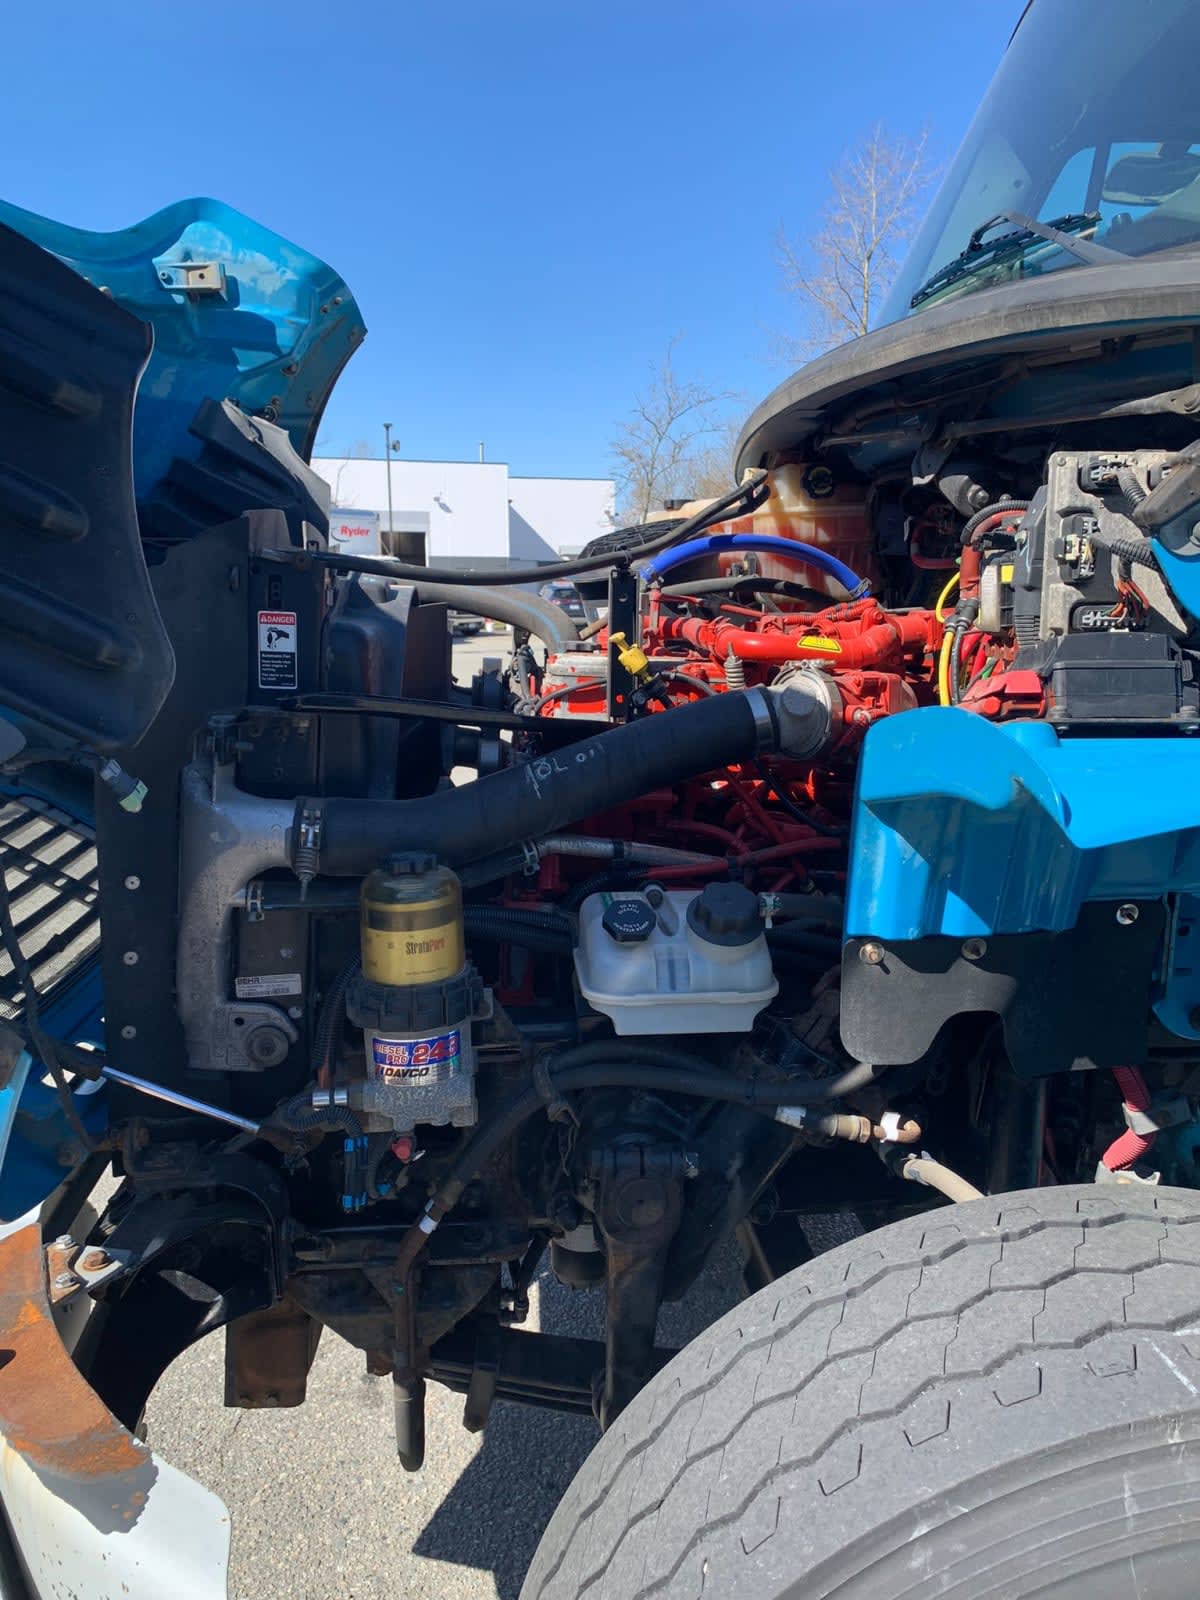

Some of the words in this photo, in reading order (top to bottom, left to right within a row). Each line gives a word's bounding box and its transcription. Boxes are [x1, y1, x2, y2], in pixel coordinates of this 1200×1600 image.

[340, 525, 370, 537] Ryder
[267, 615, 294, 624] DANGER
[374, 1043, 409, 1056] DIESEL
[386, 1054, 410, 1065] PRO
[384, 1067, 429, 1078] DAVCO
